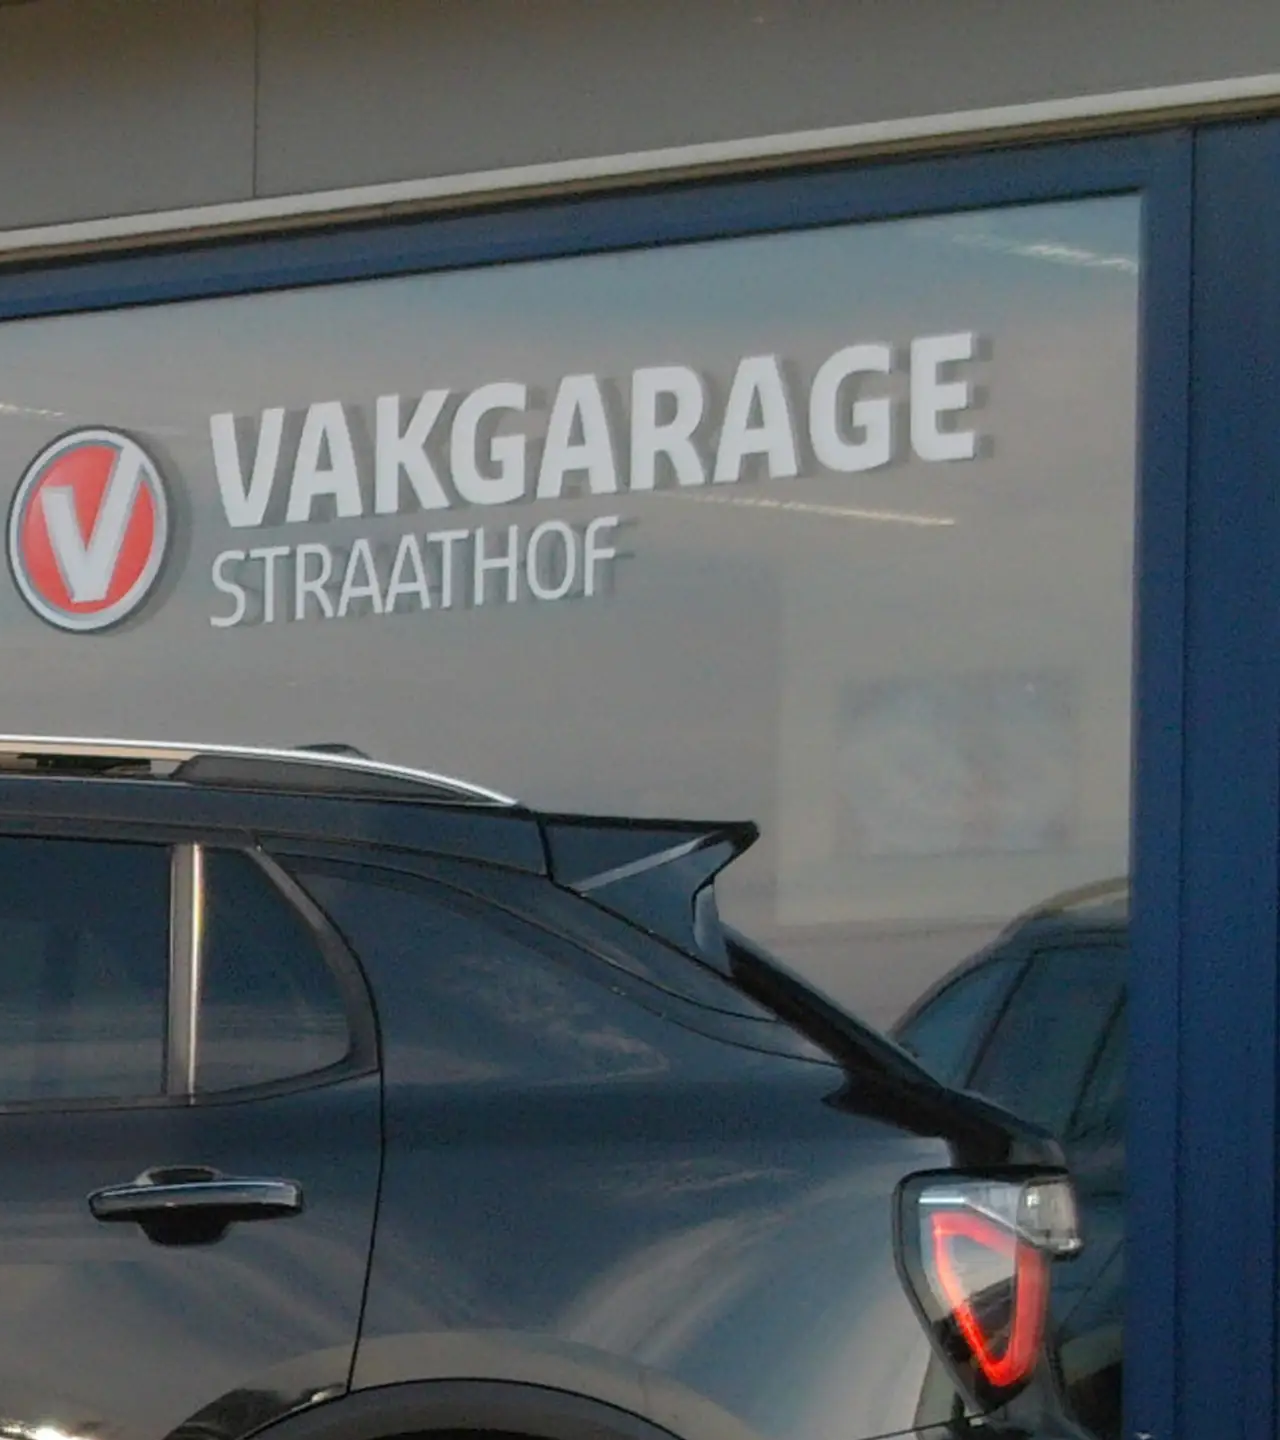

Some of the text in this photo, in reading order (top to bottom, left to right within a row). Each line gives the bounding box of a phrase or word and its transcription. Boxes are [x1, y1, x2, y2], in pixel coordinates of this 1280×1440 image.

[209, 331, 976, 528] VAKGARAGE
[40, 443, 143, 604] V
[210, 514, 620, 628] STRAATHOF
